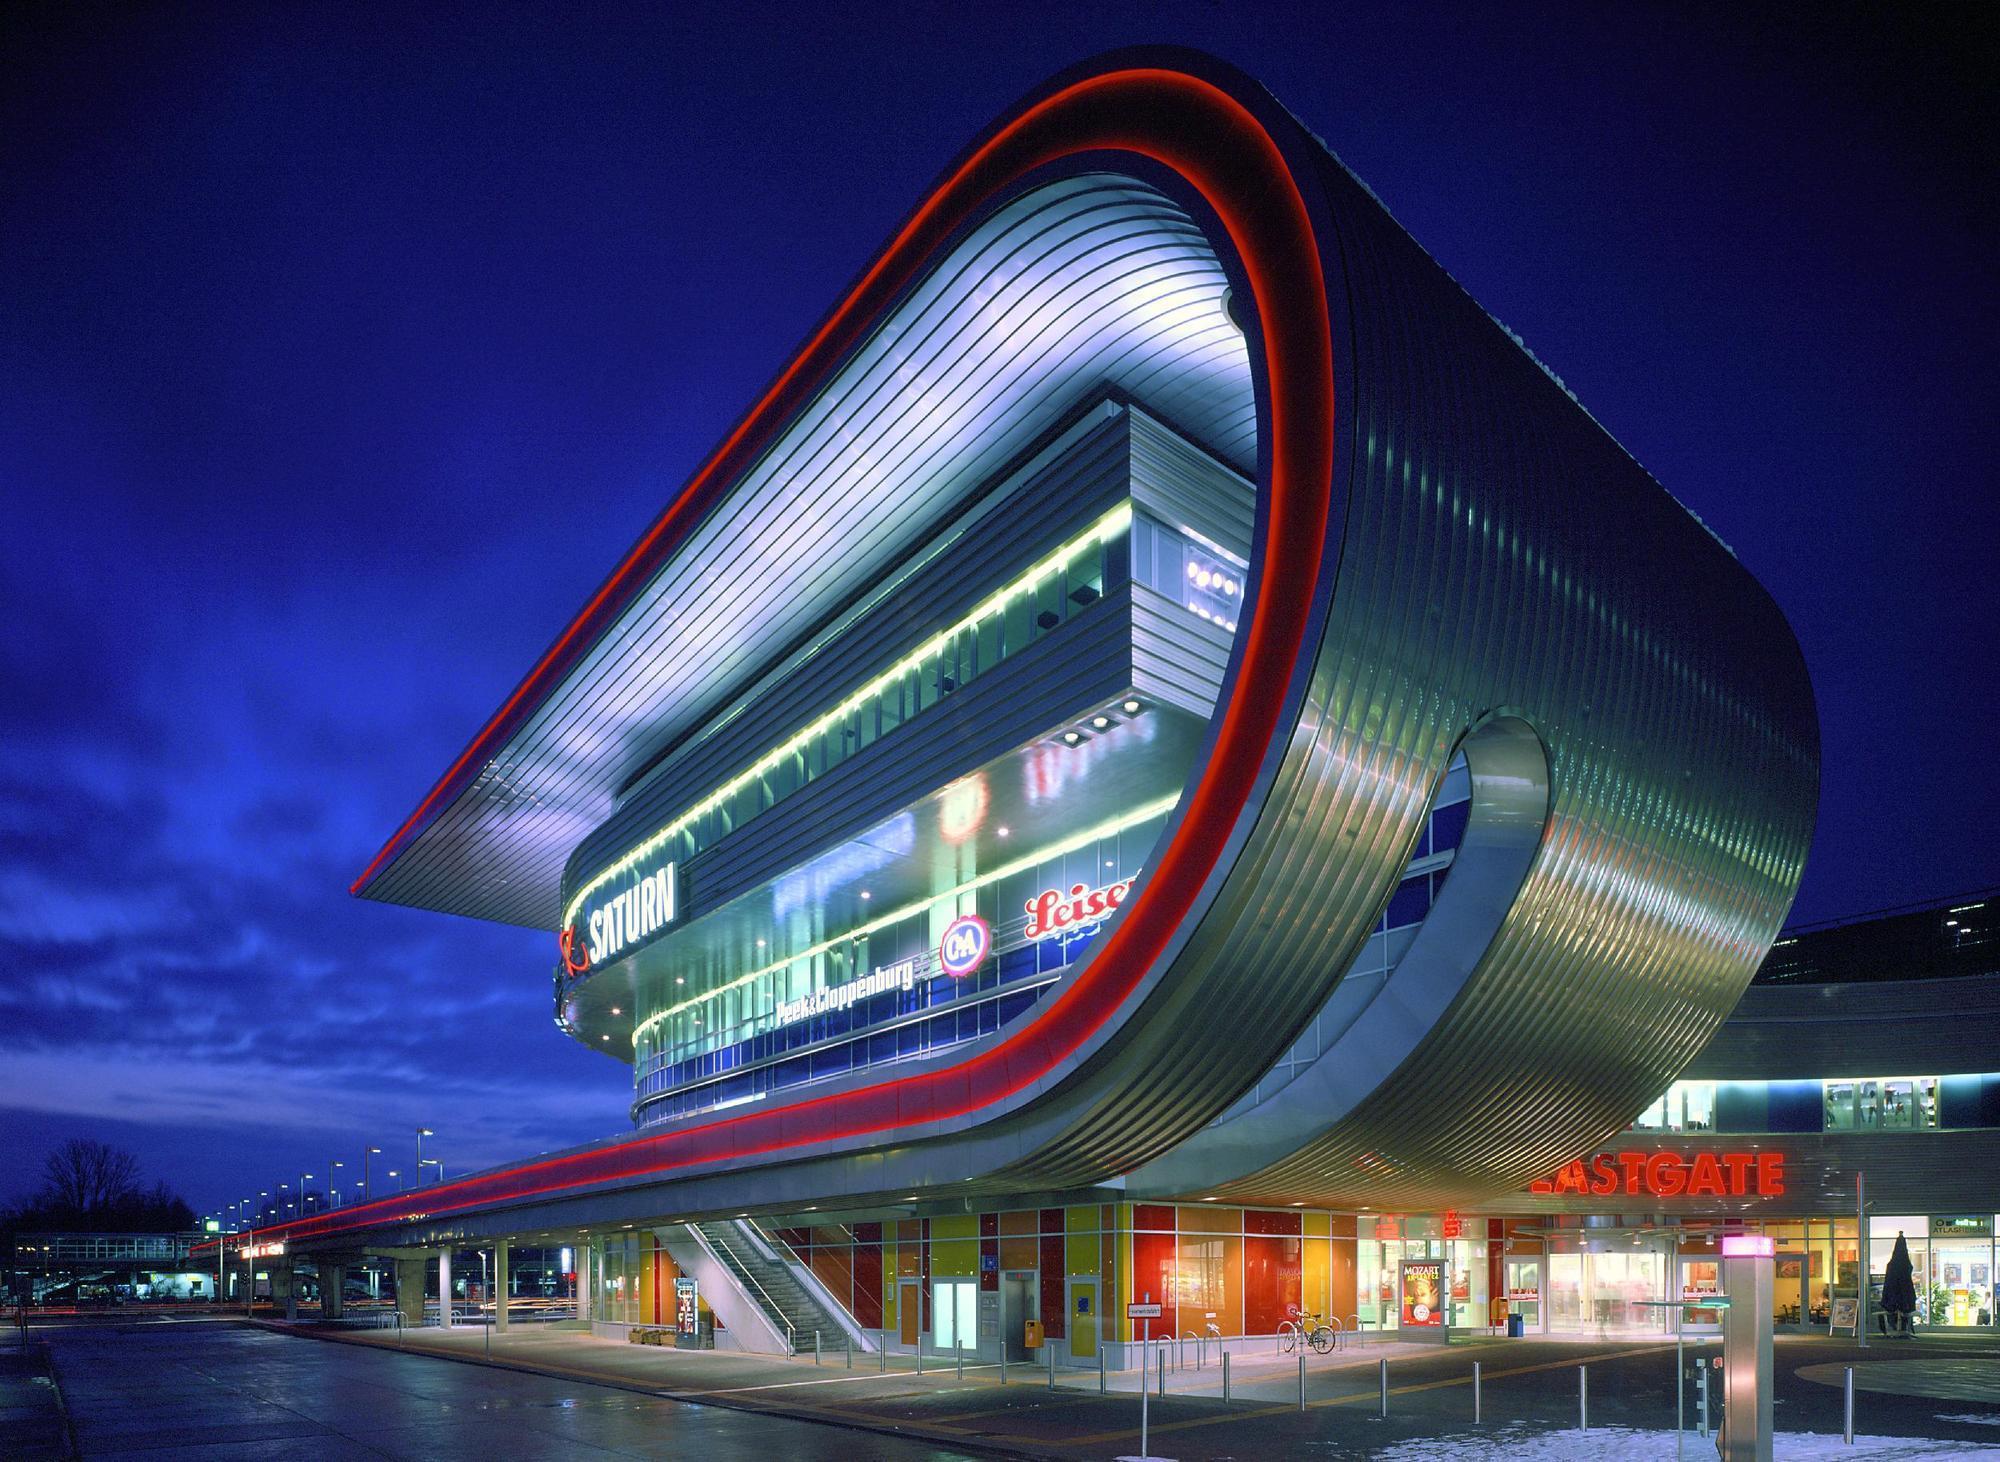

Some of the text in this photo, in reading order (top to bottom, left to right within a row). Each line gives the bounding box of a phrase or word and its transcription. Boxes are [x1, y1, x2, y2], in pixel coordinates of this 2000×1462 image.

[589, 862, 675, 964] SATURN
[1025, 880, 1135, 940] Leise
[1404, 1266, 1440, 1275] MOZART
